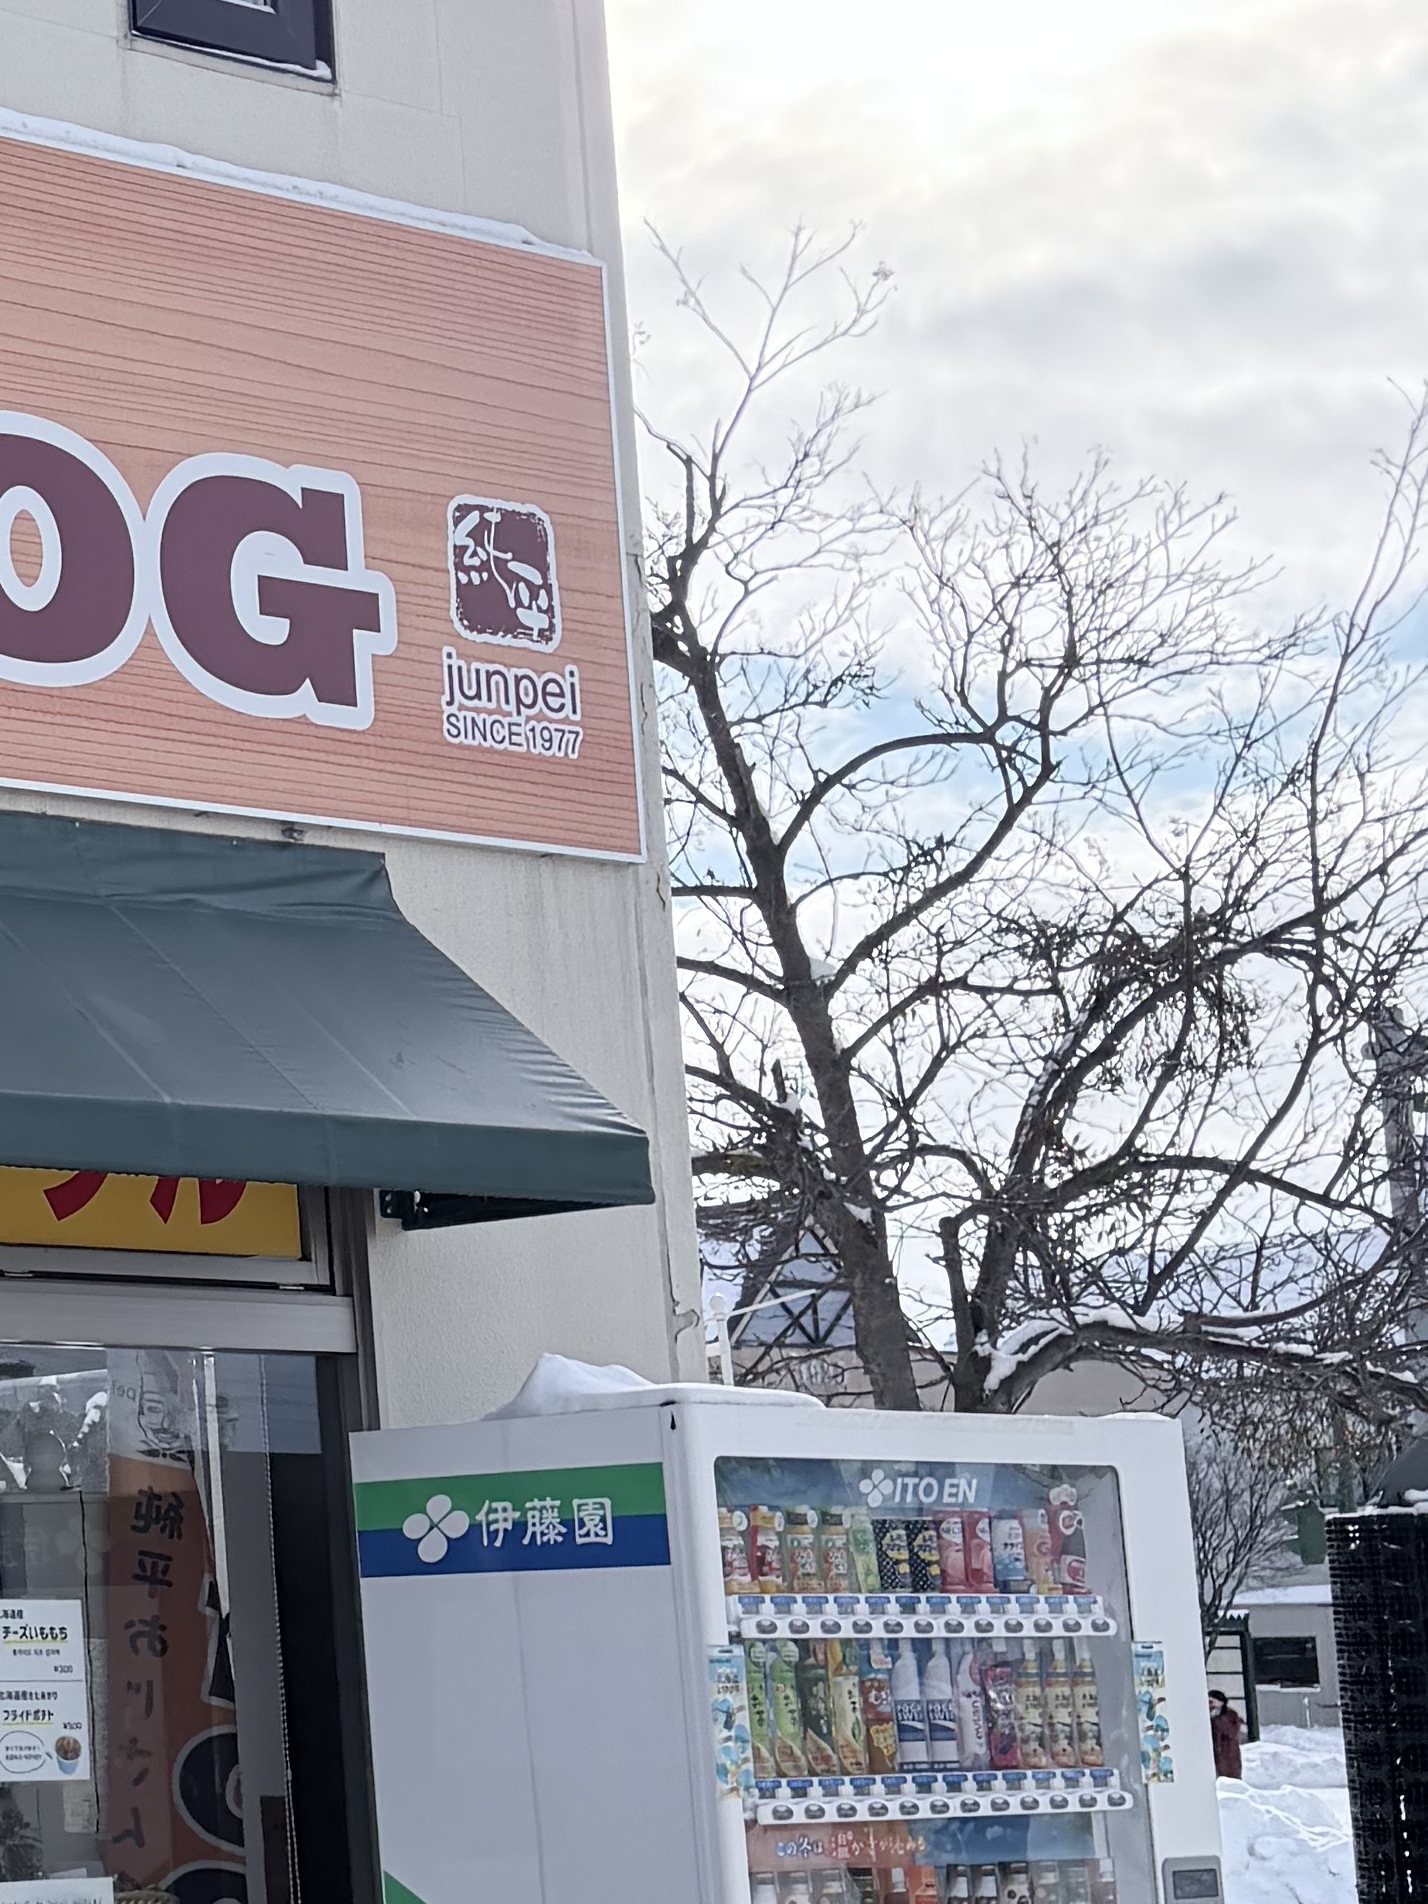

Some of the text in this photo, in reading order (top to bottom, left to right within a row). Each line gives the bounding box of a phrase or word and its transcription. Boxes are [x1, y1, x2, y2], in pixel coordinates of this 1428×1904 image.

[445, 651, 578, 717] junpei
[894, 1477, 978, 1504] ITO EN
[475, 1496, 613, 1548] 伊藤園
[2, 1624, 69, 1641] チーズいももち
[2, 1709, 54, 1723] フライドポテト
